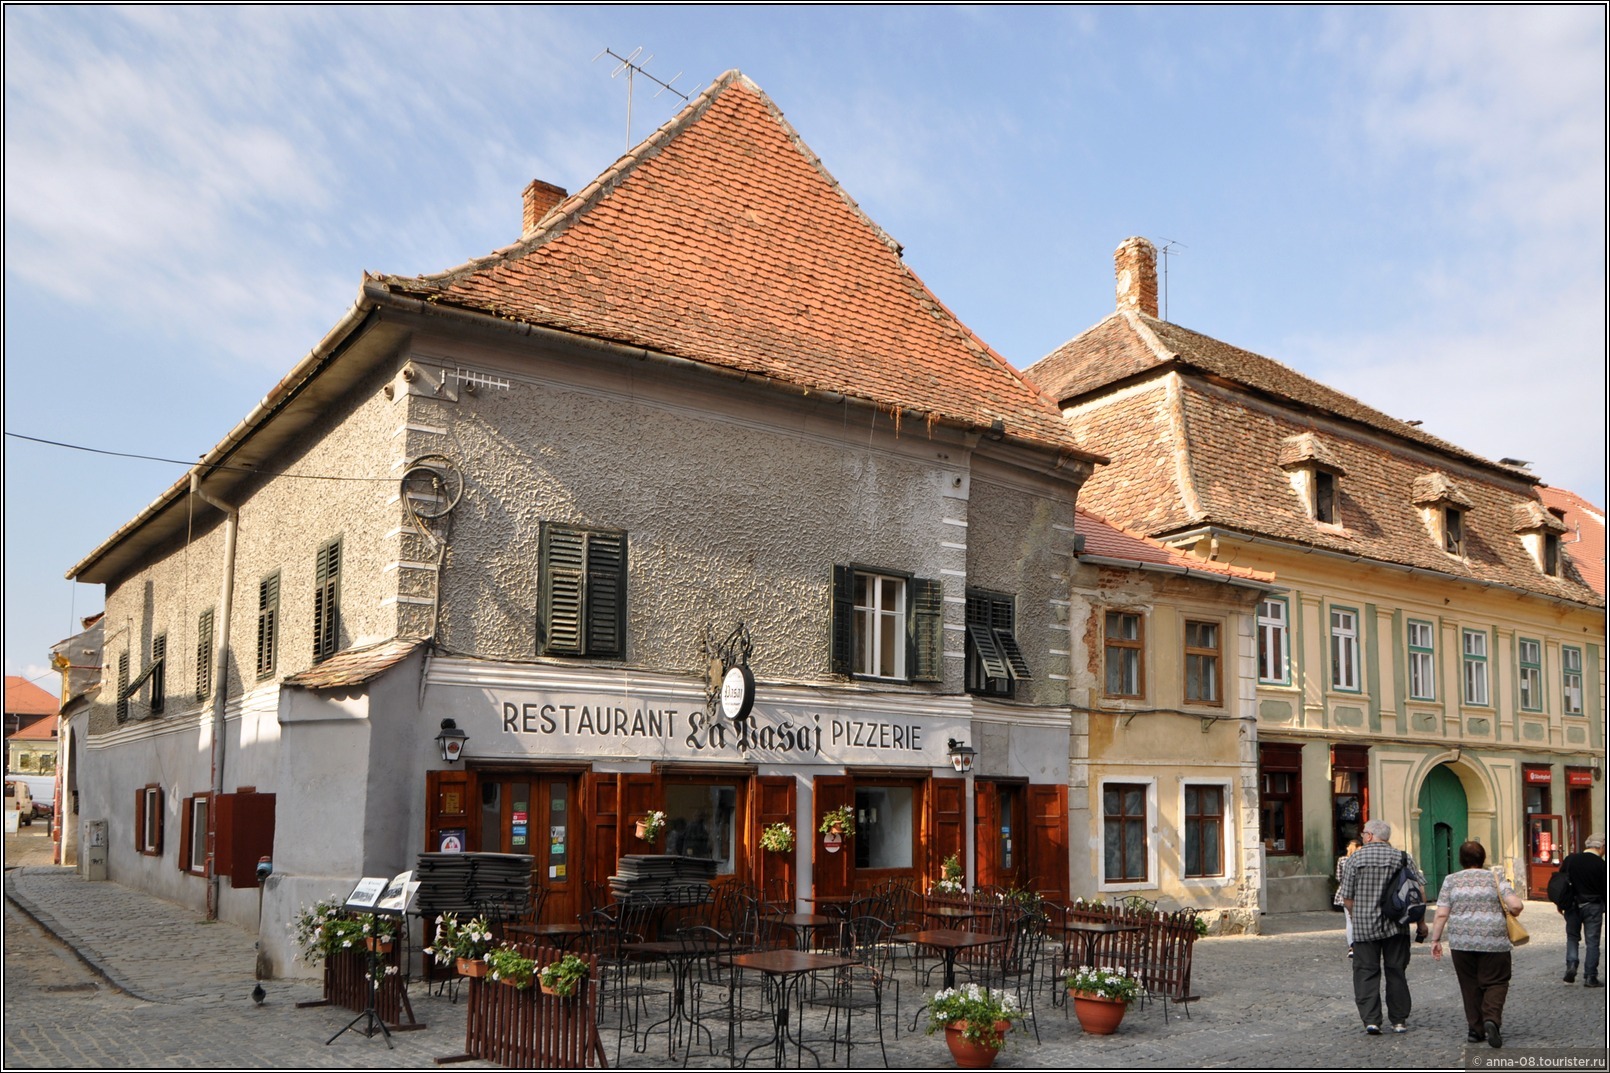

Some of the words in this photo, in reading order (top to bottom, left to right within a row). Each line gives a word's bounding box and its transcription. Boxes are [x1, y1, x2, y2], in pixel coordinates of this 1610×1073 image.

[503, 702, 678, 738] RESTAURANT
[685, 711, 727, 750] La
[831, 719, 923, 751] PIZZERIE
